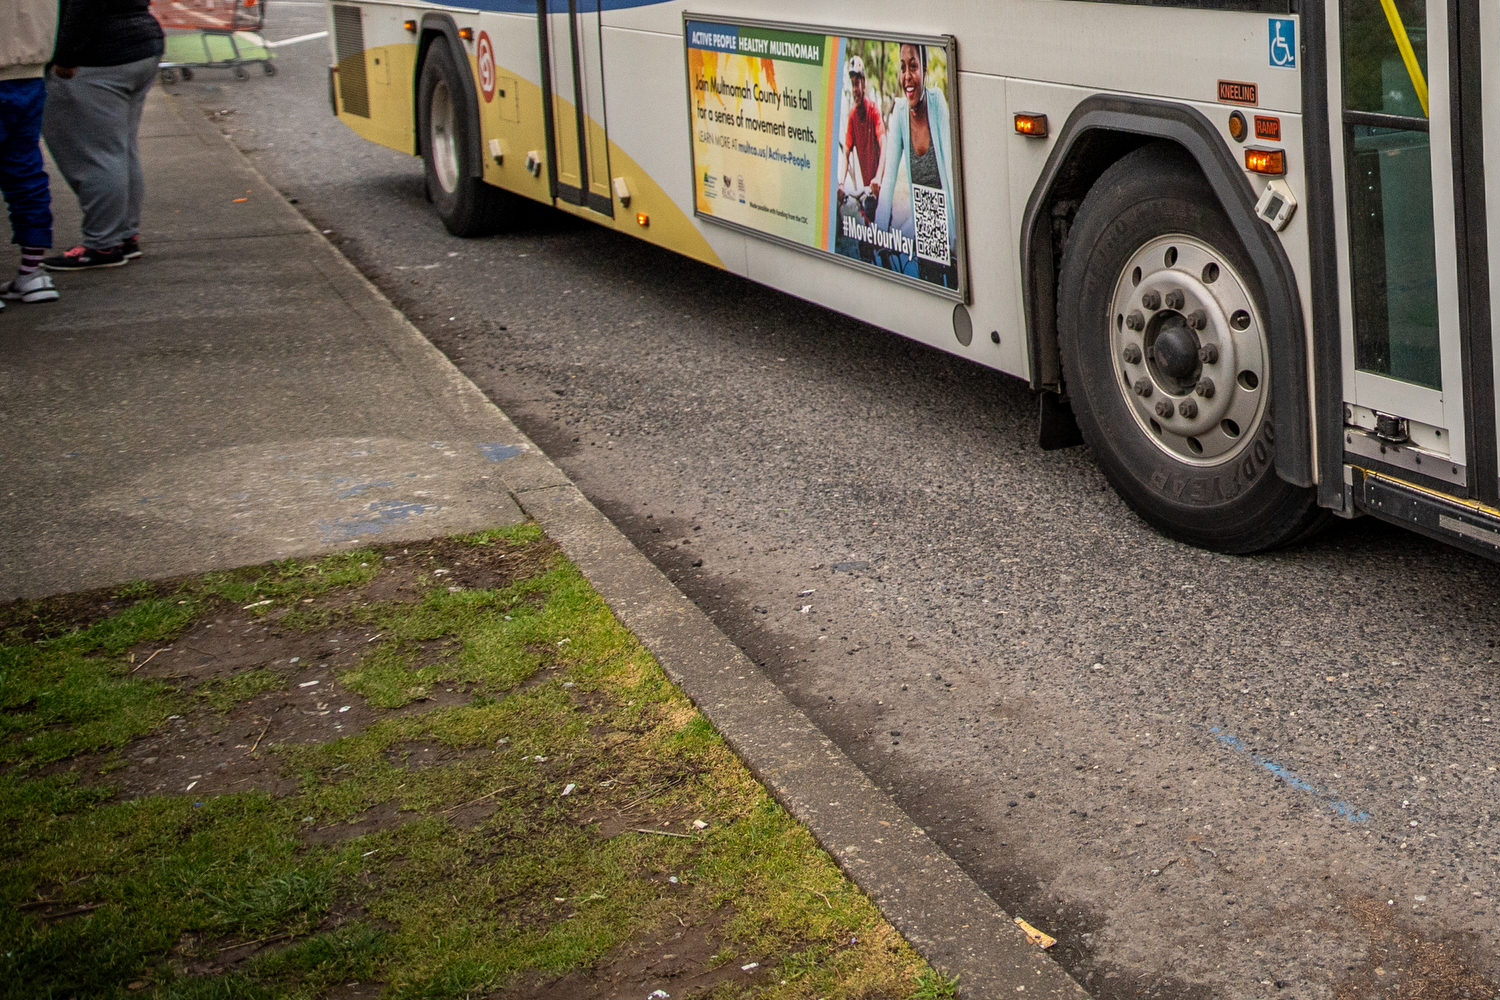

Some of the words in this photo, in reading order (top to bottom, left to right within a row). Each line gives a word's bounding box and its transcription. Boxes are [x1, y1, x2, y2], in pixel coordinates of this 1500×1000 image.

[692, 31, 712, 47] ACTIVE
[713, 33, 736, 50] PEOPLE
[738, 36, 768, 54] HEALTHY
[769, 40, 819, 61] MULTNOMAH
[695, 73, 709, 92] Join
[710, 75, 752, 100] Multnomah
[753, 83, 781, 111] County
[783, 86, 798, 109] this
[799, 88, 813, 111] fall
[1220, 83, 1255, 102] KNEELING
[697, 100, 707, 119] for
[708, 109, 713, 121] a
[714, 107, 734, 126] series
[736, 108, 745, 128] of
[745, 117, 785, 137] movement
[787, 126, 817, 144] events.
[1256, 120, 1278, 135] RAMP
[699, 130, 714, 145] LEARN
[715, 132, 731, 149] MORE
[731, 138, 737, 151] AT
[738, 140, 811, 171] multco.us/Active-People
[842, 215, 914, 261] #MoveYourWay
